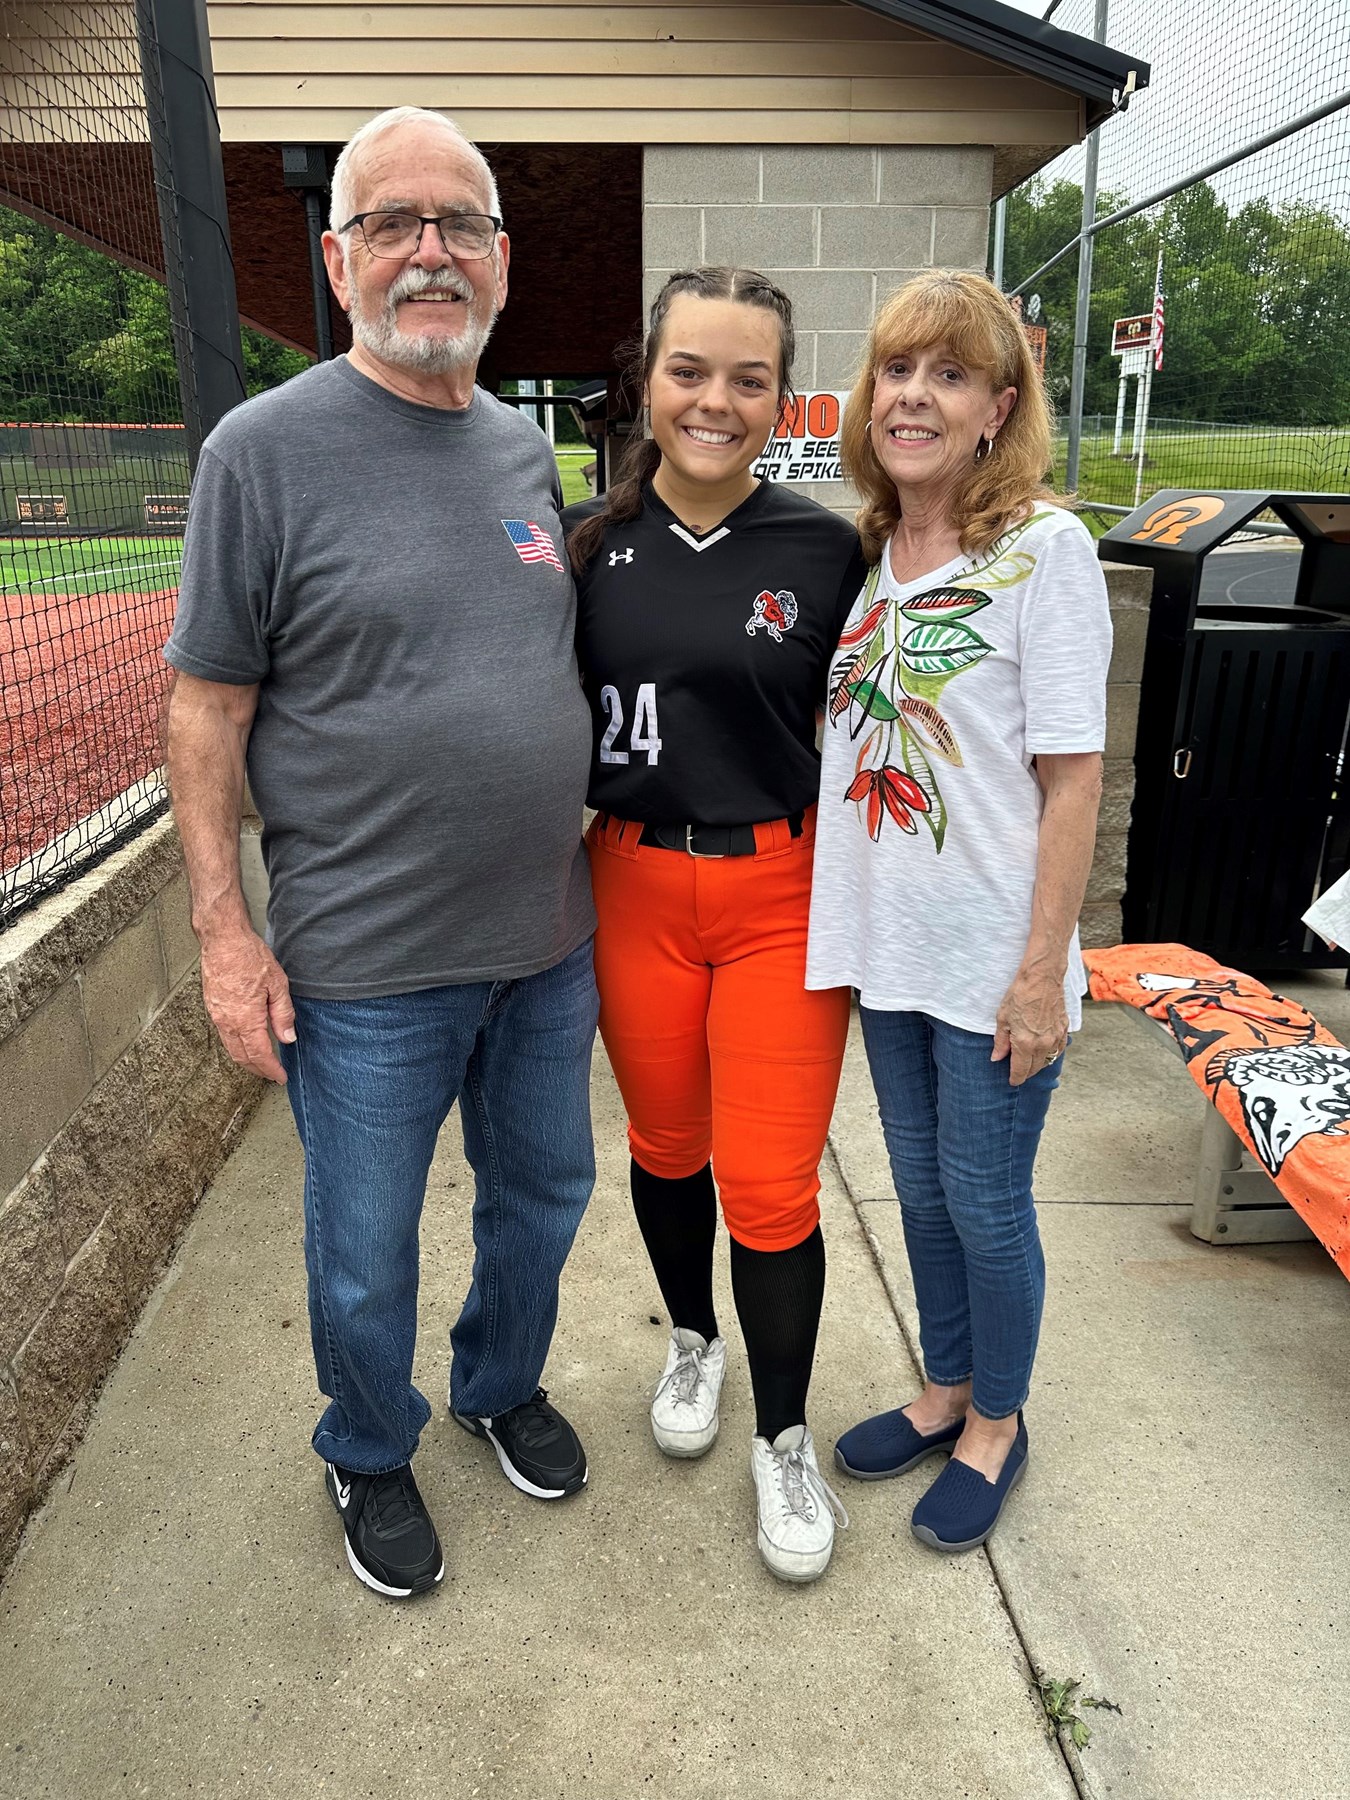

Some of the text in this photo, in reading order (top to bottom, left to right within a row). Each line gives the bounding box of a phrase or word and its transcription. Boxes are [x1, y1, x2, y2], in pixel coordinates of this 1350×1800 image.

[774, 393, 840, 439] NO
[754, 463, 781, 480] OR
[600, 683, 662, 766] 24
